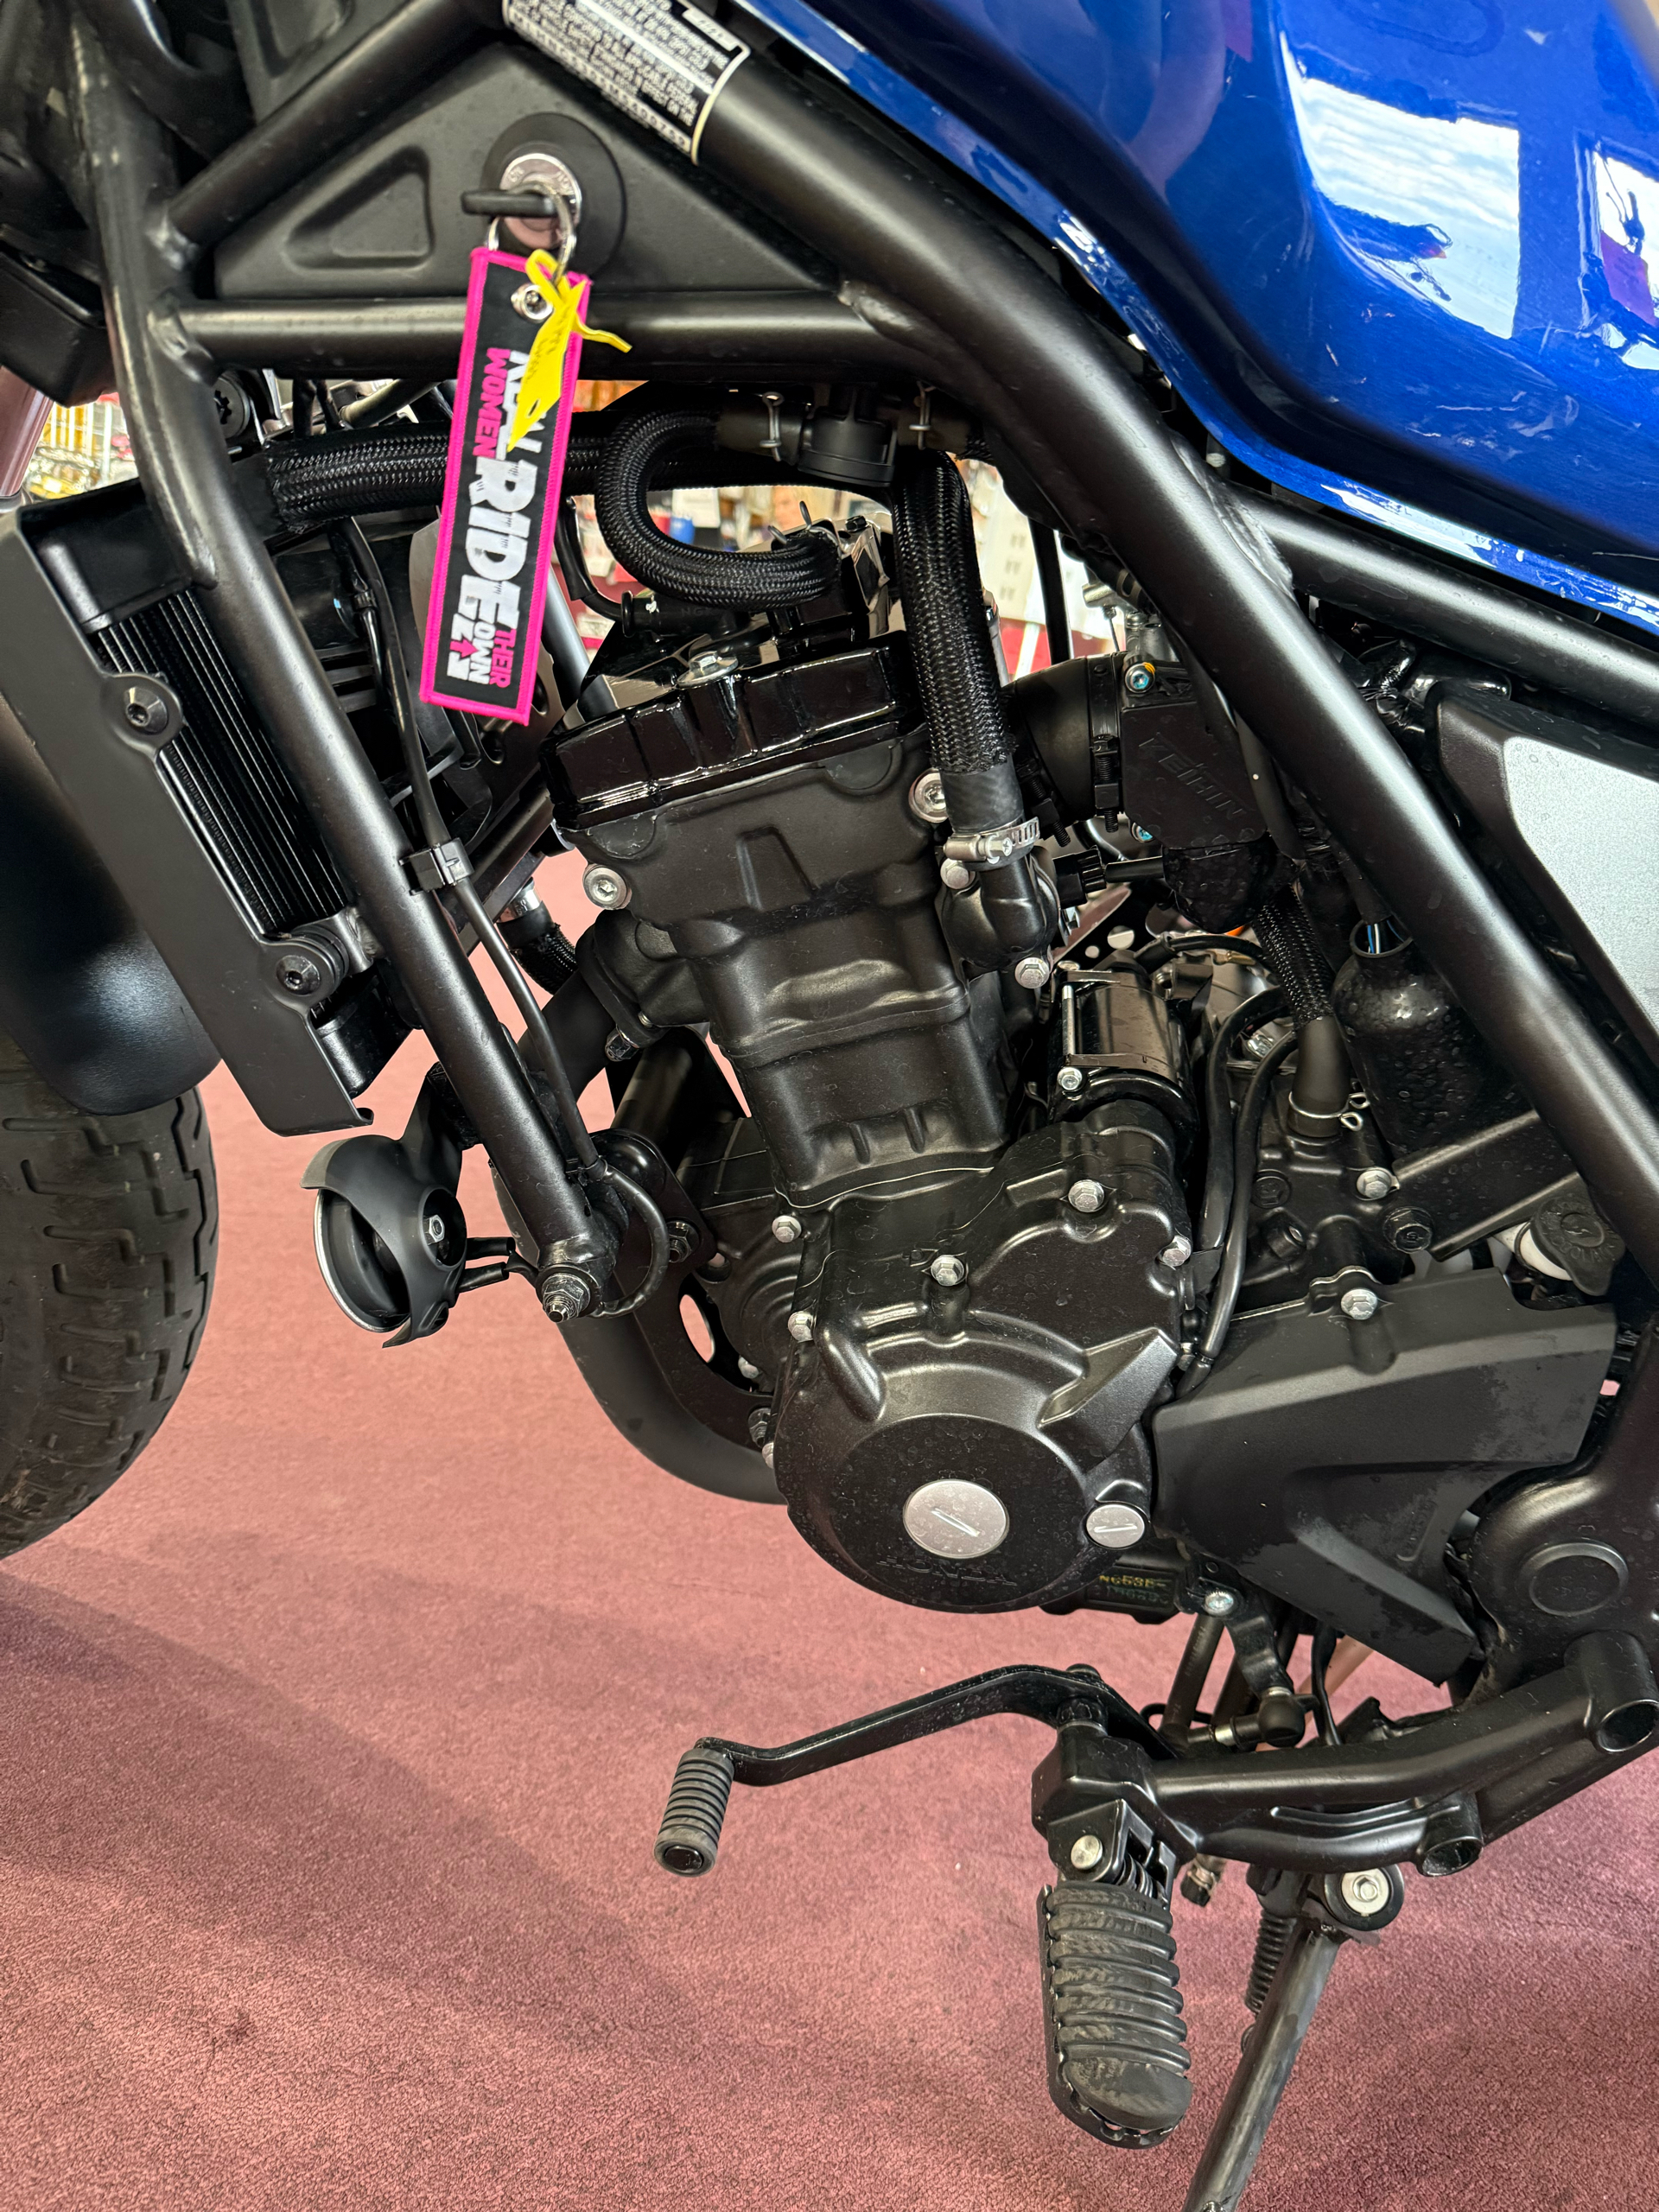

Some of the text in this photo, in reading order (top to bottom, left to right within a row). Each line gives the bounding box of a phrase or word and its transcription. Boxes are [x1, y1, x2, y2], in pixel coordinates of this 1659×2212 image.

[472, 347, 511, 458] WOMEN
[458, 456, 538, 630] RIDE
[468, 620, 497, 685] OWN
[489, 626, 517, 689] THEIR
[1138, 737, 1247, 818] KEIHIN
[875, 1553, 1017, 1586] HONDA
